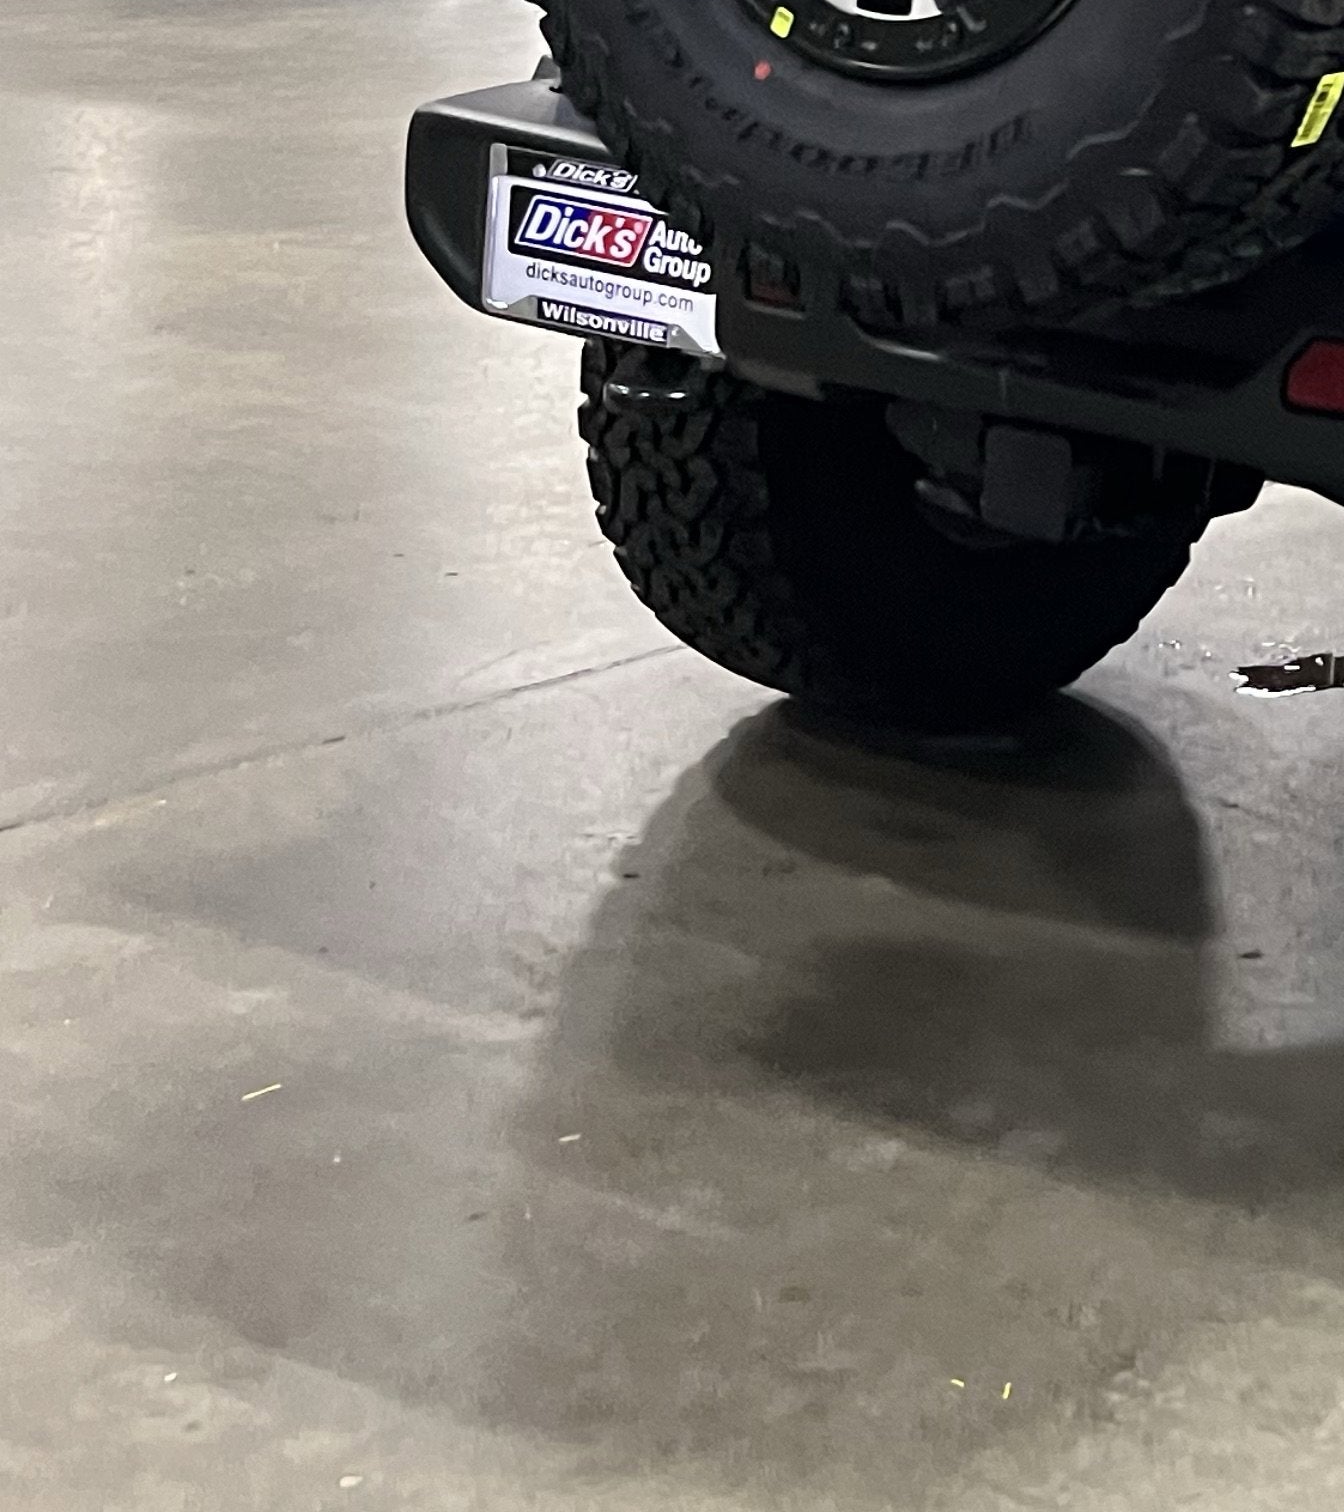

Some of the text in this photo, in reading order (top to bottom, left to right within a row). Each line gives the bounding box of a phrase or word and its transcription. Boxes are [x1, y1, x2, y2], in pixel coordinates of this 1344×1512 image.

[524, 203, 637, 259] Dick's
[525, 261, 695, 313] dicksautogroup.com
[642, 246, 712, 288] Group
[541, 301, 668, 342] Wilsonville
